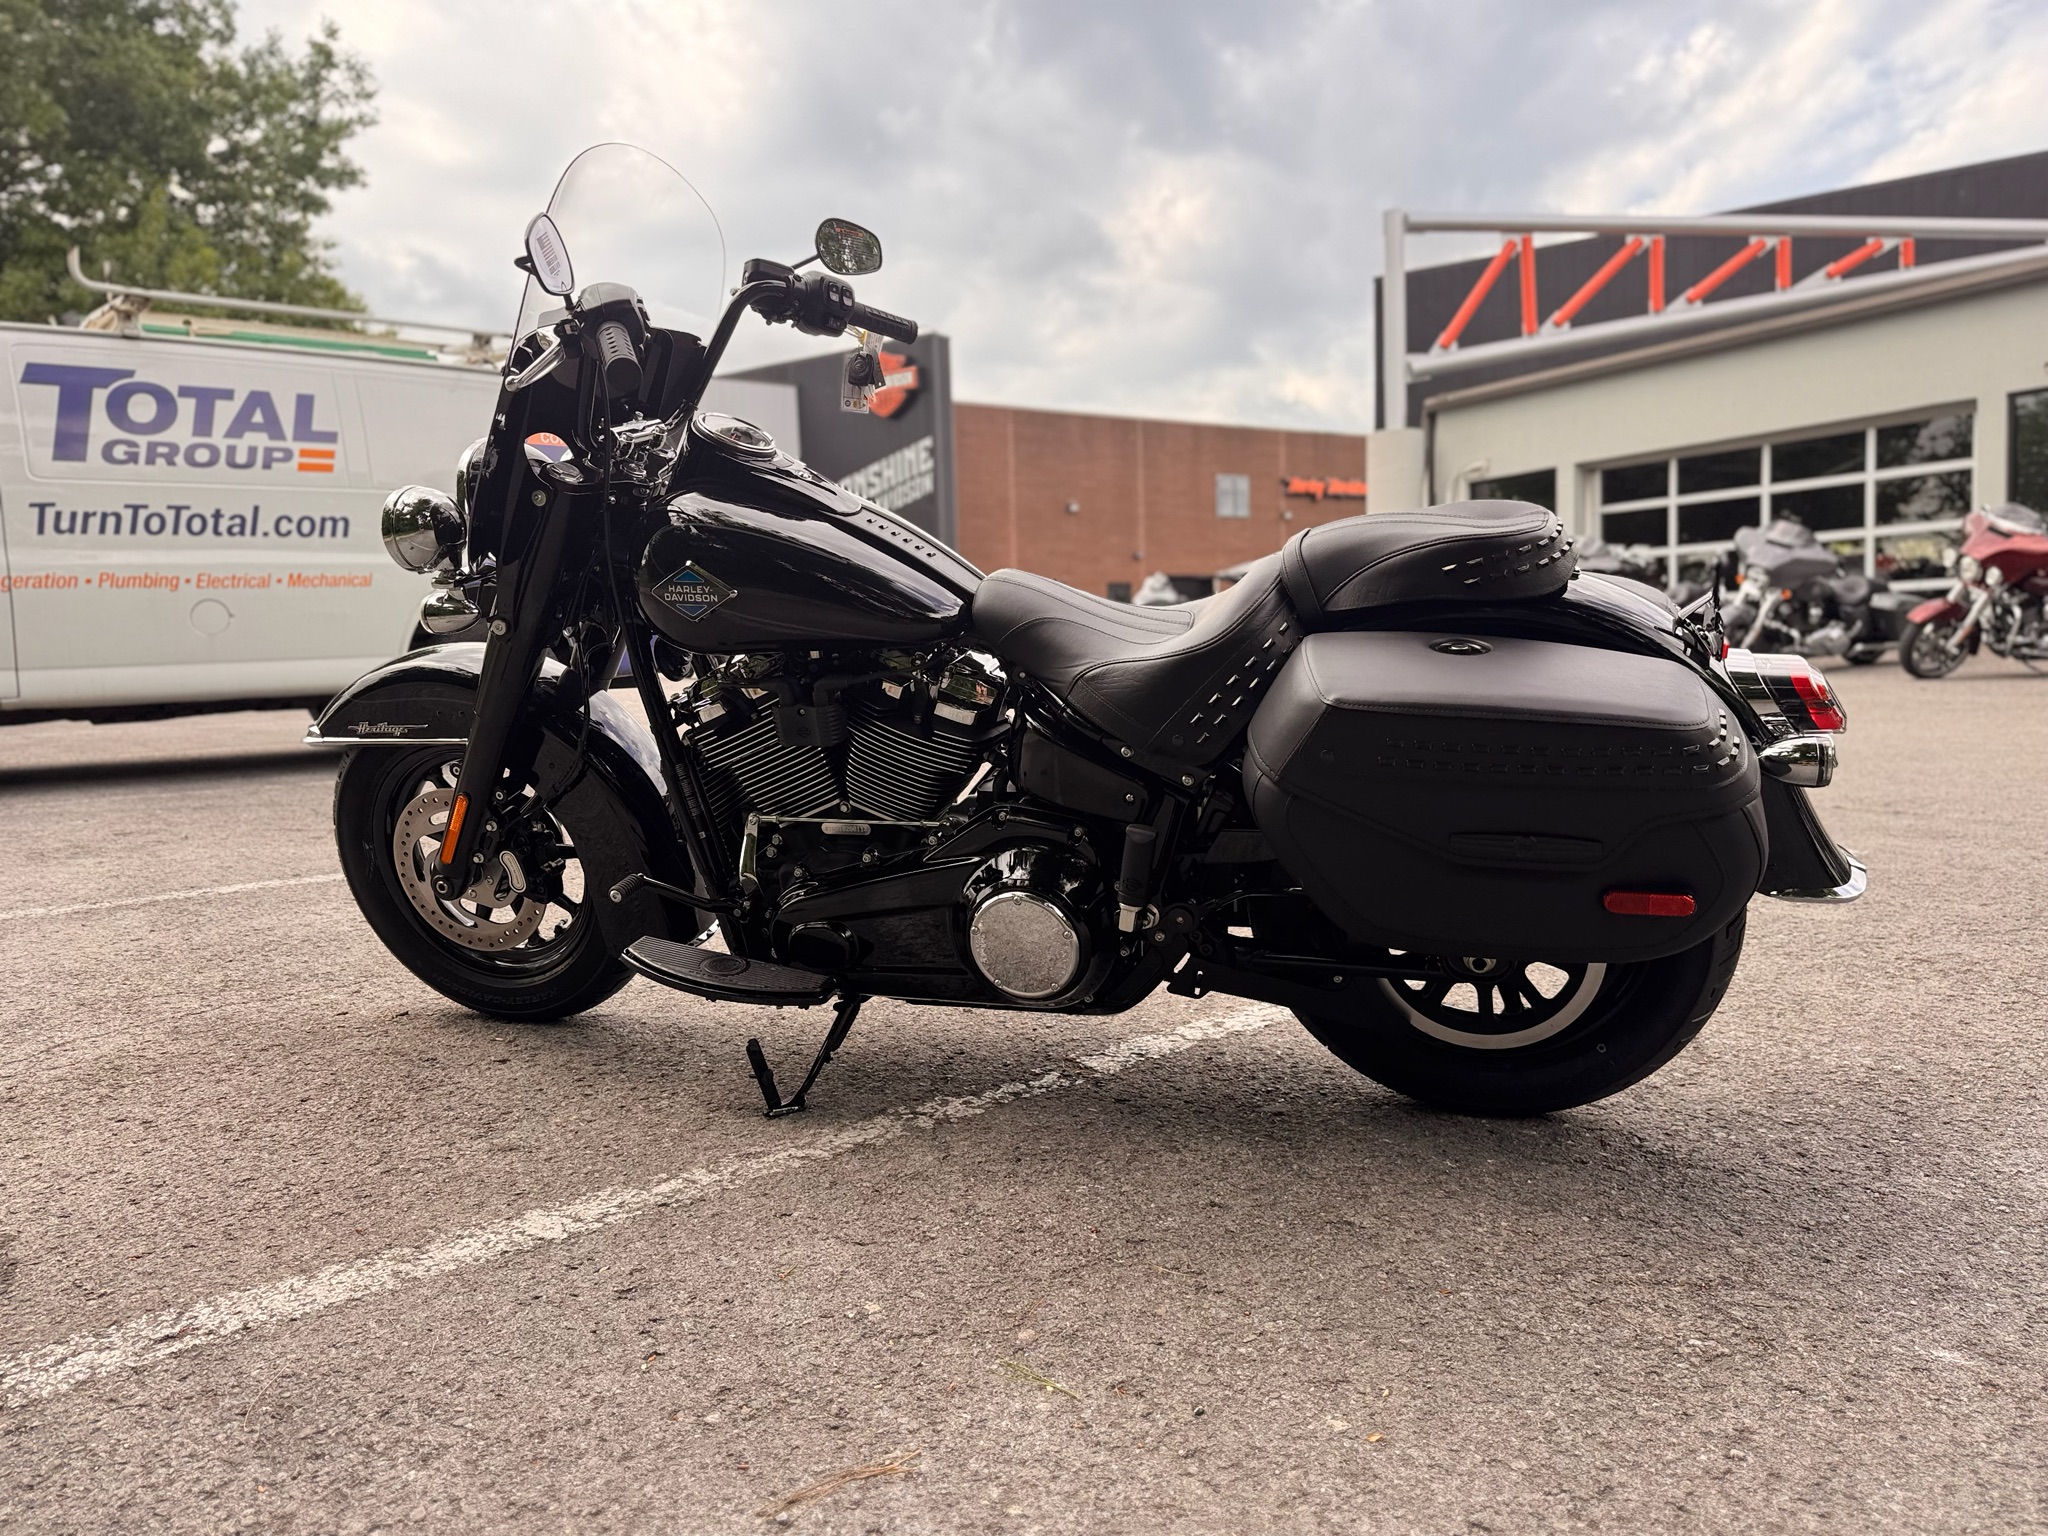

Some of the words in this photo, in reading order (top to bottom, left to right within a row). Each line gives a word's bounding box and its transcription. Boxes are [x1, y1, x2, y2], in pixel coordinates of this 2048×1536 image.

[19, 362, 339, 462] TOTAL
[101, 438, 294, 470] GROUP
[29, 502, 350, 538] TurnToTotal.com
[98, 572, 180, 592] Plumbing
[196, 573, 271, 589] Electrical
[287, 572, 373, 588] Mechanical
[668, 585, 713, 594] HARLEY-
[664, 593, 718, 602] DAVIDSON
